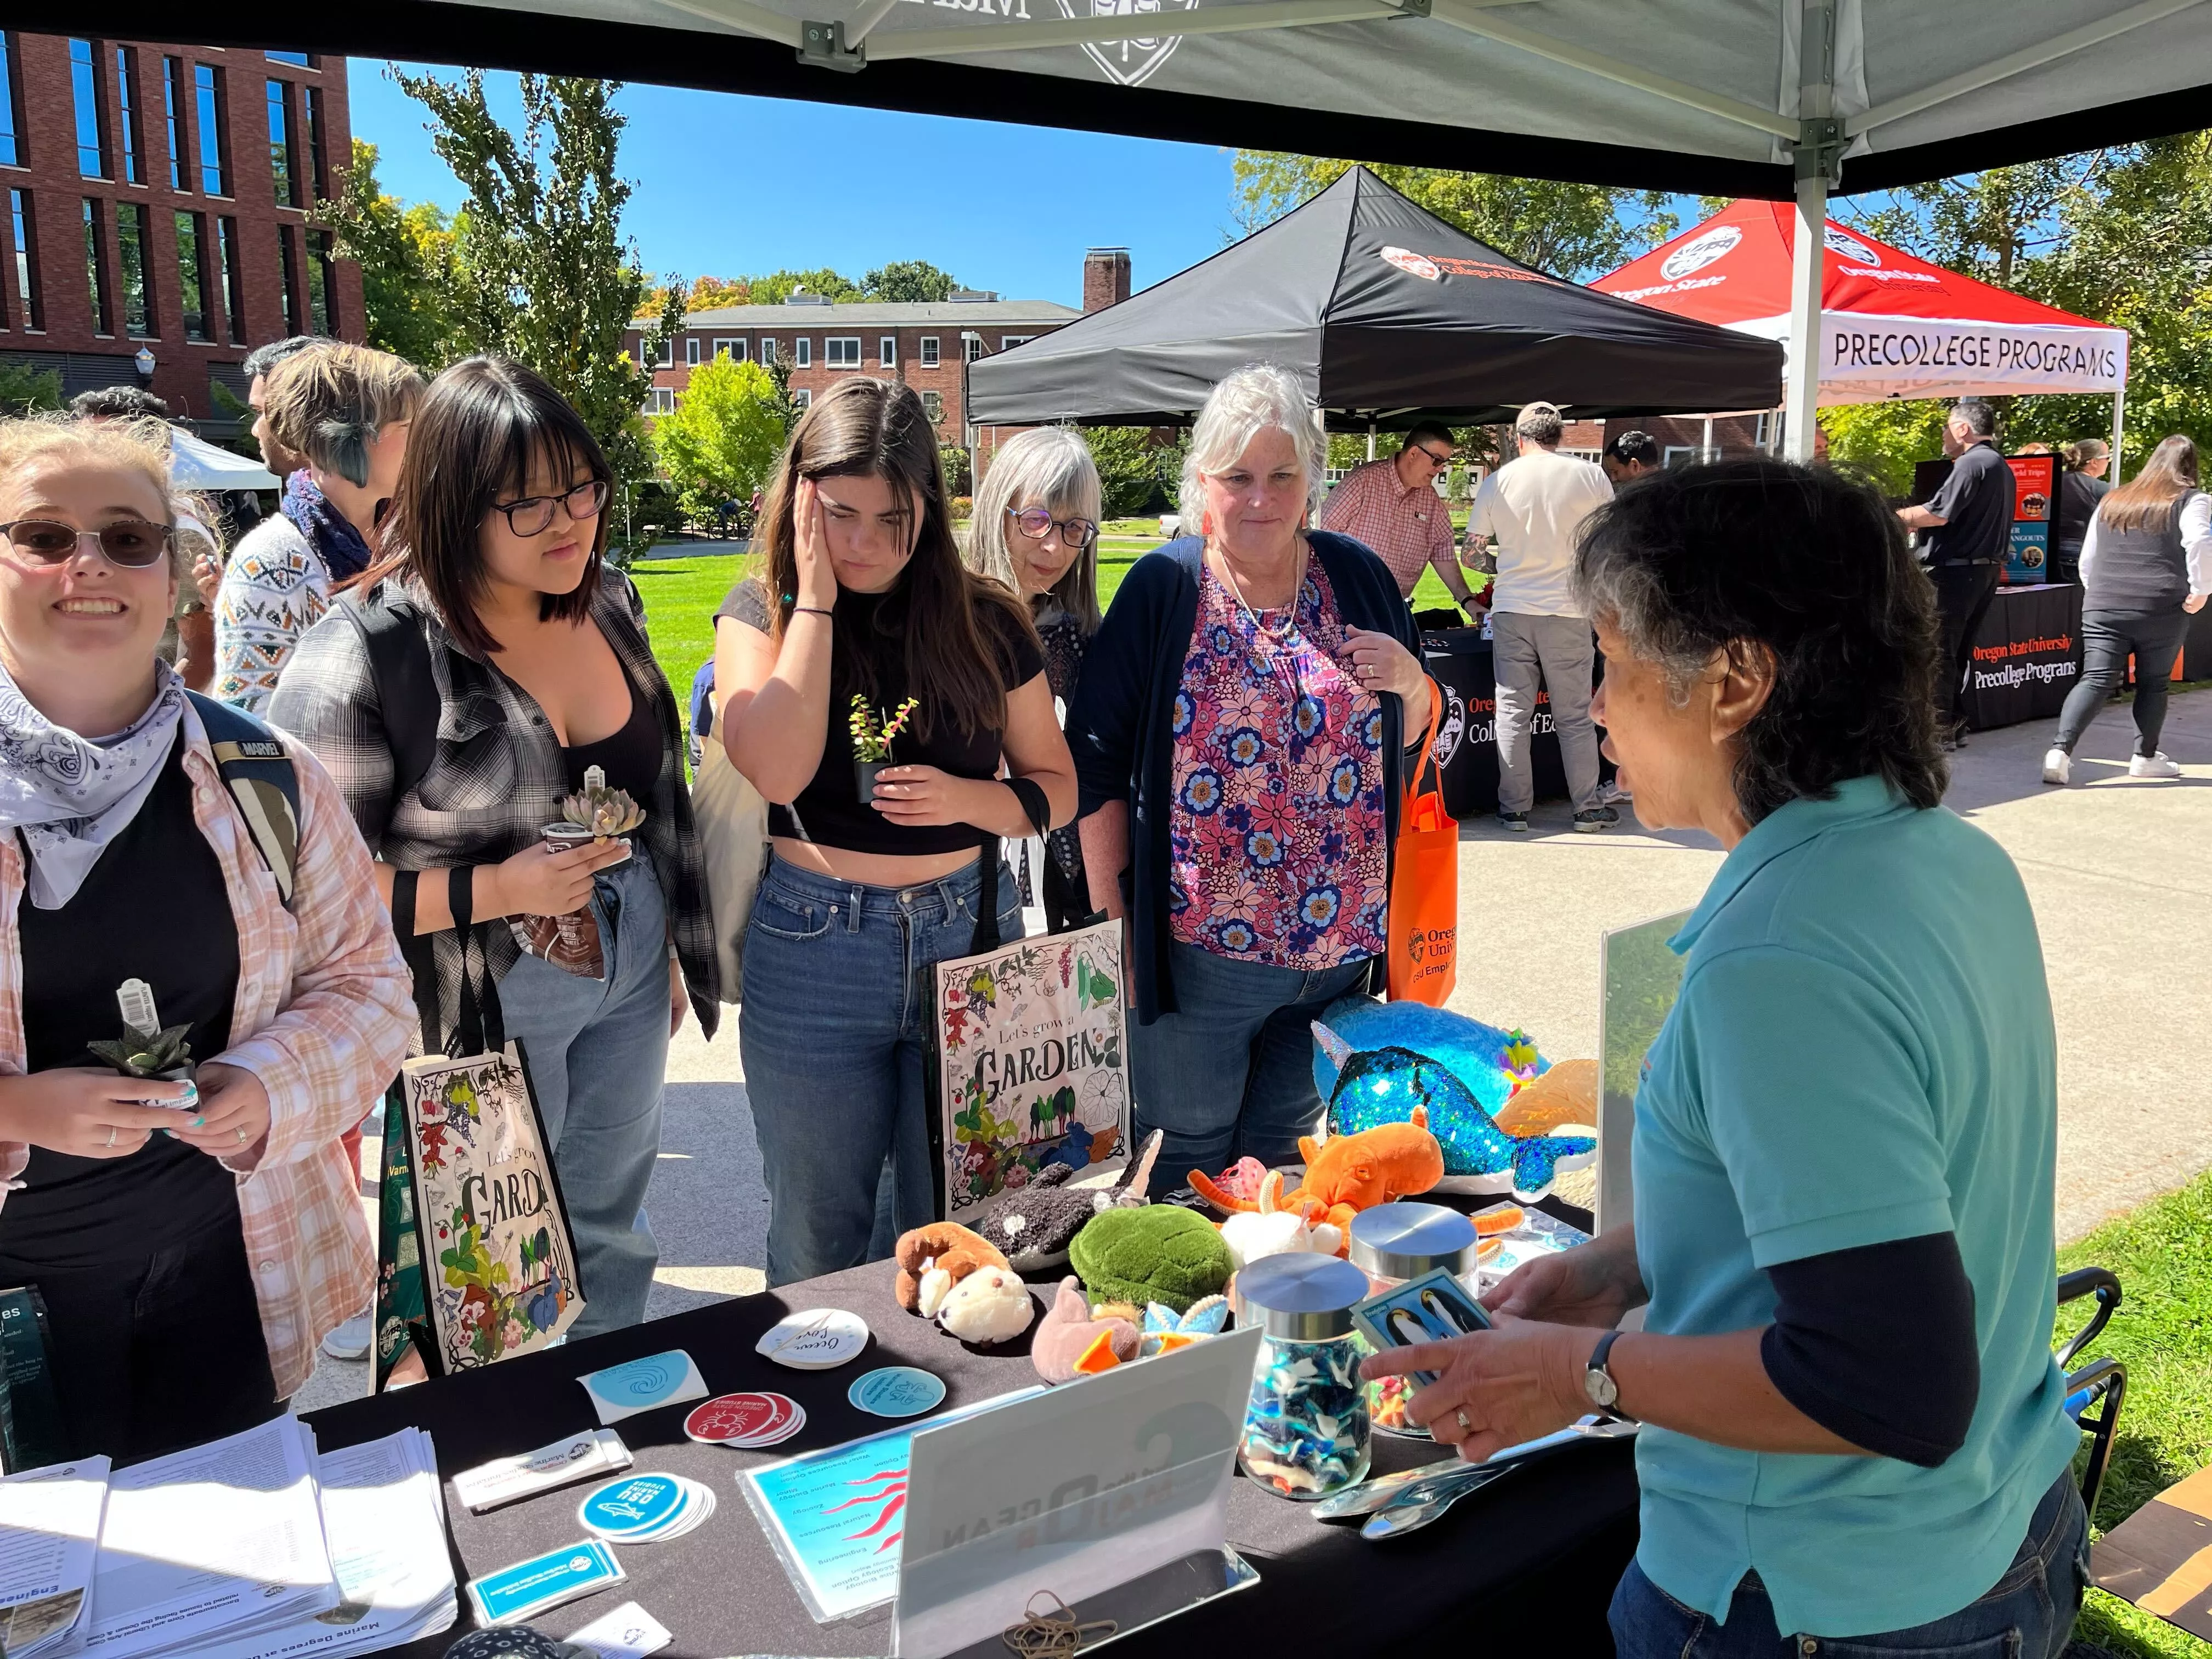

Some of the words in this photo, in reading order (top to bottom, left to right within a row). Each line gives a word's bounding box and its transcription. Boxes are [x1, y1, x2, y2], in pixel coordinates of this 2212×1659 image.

[1838, 264, 1883, 280] Oregon
[1889, 268, 1940, 284] State
[1677, 274, 1727, 296] State
[1870, 279, 1950, 297] University
[1835, 333, 1990, 367] PRECOLLEGE
[1997, 338, 2116, 378] PROGRAMS
[1973, 644, 2007, 663] Oregon
[2010, 641, 2028, 657] State
[2028, 634, 2073, 653] University
[1975, 663, 2026, 690] Precollege
[2025, 659, 2076, 684] Programs
[243, 742, 280, 756] MARVEL
[997, 1023, 1029, 1045] Let's
[1032, 1019, 1063, 1041] grow
[1068, 1015, 1074, 1025] a
[975, 1027, 1098, 1104] GARDEN
[487, 1149, 512, 1167] Let's
[794, 1337, 839, 1351] Ocean
[533, 1453, 565, 1467] Marine
[780, 1472, 806, 1483] Option
[616, 1490, 654, 1504] OSU
[775, 1487, 798, 1497] Minor
[778, 1489, 808, 1502] Biology
[792, 1503, 824, 1516] Zoology
[842, 1513, 871, 1525] Natural
[798, 1523, 841, 1538] Resources
[817, 1547, 867, 1565] Engineering
[861, 1564, 894, 1578] Ecology
[831, 1576, 860, 1588] Option
[844, 1576, 878, 1592] Biology
[213, 1593, 239, 1604] related
[185, 1598, 240, 1617] Baccalaureate
[154, 1611, 178, 1622] facing
[167, 1615, 185, 1623] Core
[115, 1622, 140, 1634] Ocean
[123, 1625, 150, 1637] Liberal
[151, 1620, 166, 1628] and
[336, 1622, 380, 1638] Marine
[280, 1635, 334, 1653] Degrees
